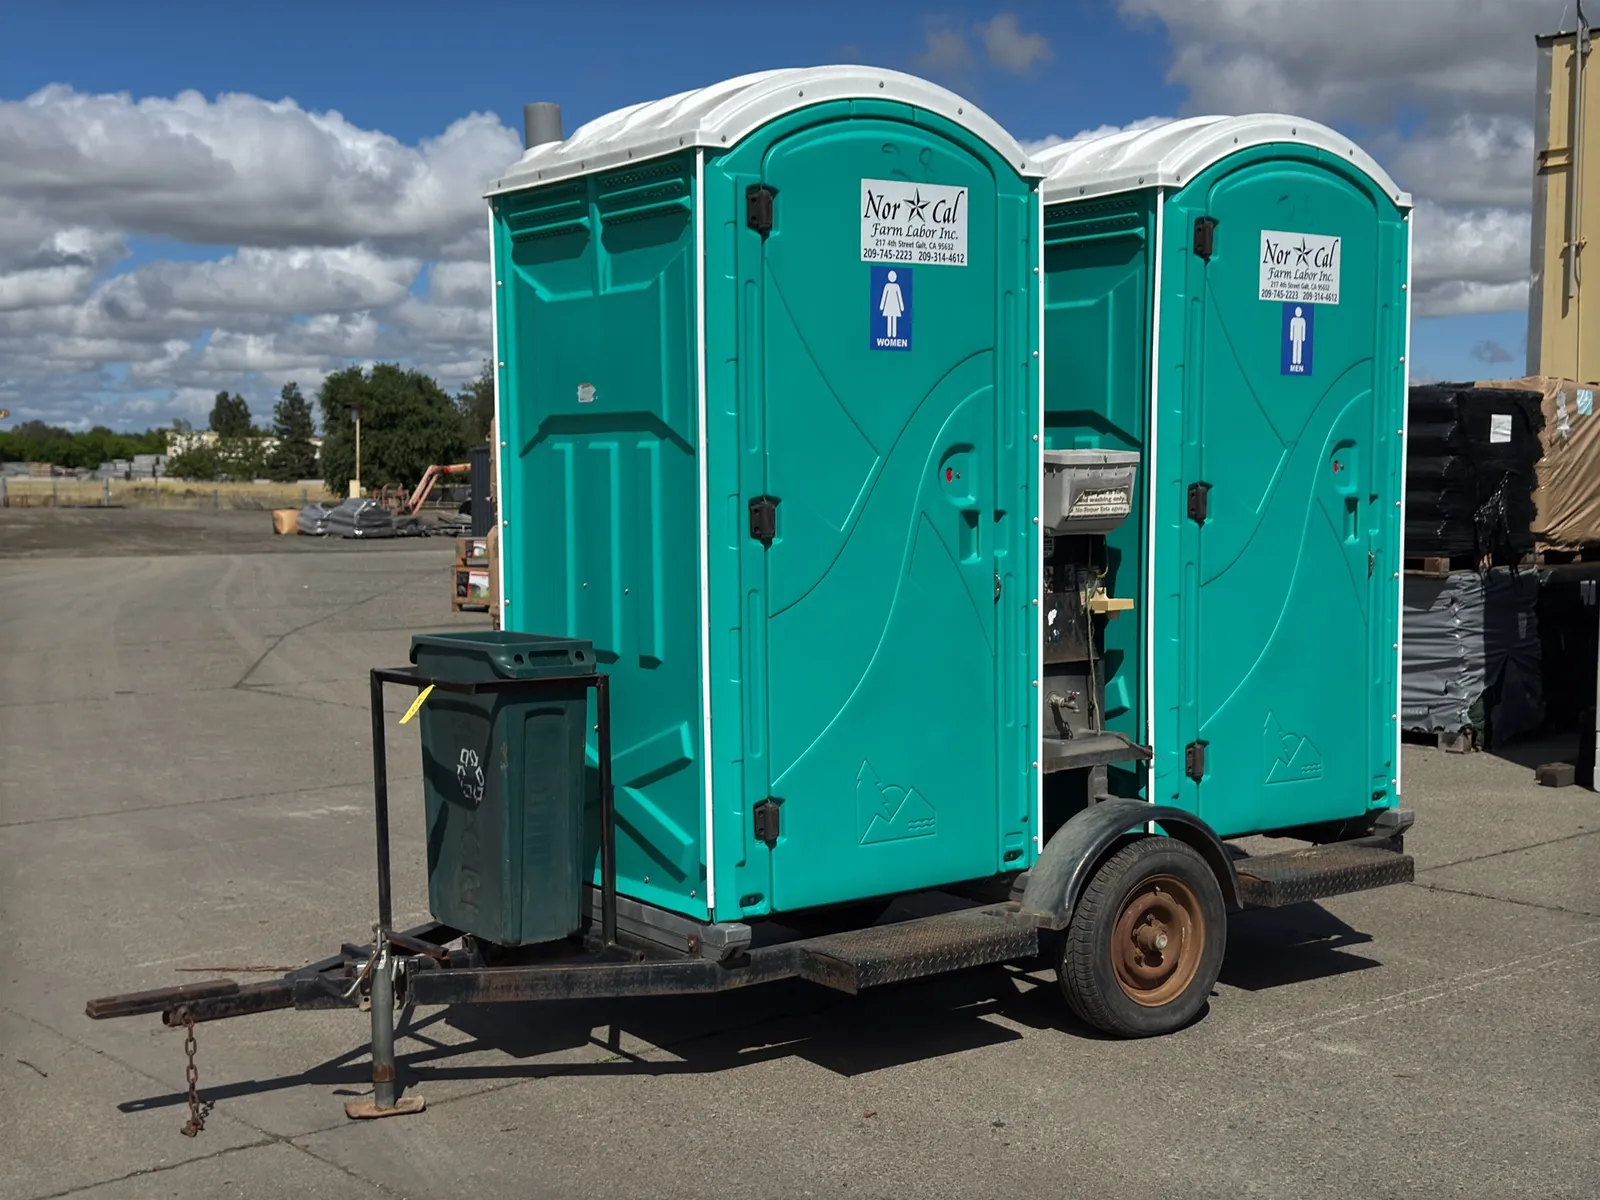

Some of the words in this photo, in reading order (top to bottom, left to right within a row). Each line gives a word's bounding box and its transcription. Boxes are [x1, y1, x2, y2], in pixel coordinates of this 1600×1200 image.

[864, 189, 900, 220] Nor
[932, 190, 965, 224] Cal
[871, 222, 903, 237] Farm
[905, 224, 937, 239] Labor
[938, 227, 958, 240] Inc.
[898, 240, 914, 248] Street
[863, 248, 912, 260] 209-745-2223
[918, 251, 964, 263] 209-314-4612
[1262, 238, 1291, 266] Nor
[1314, 239, 1339, 268] Cal
[1267, 267, 1292, 280] Farm
[1293, 268, 1318, 280] Labor
[1319, 270, 1334, 282] Inc.
[1261, 289, 1298, 299] 209-745-2223
[1302, 291, 1338, 302] 209-314-4612
[876, 338, 908, 348] WOMEN
[1289, 364, 1304, 372] MEN
